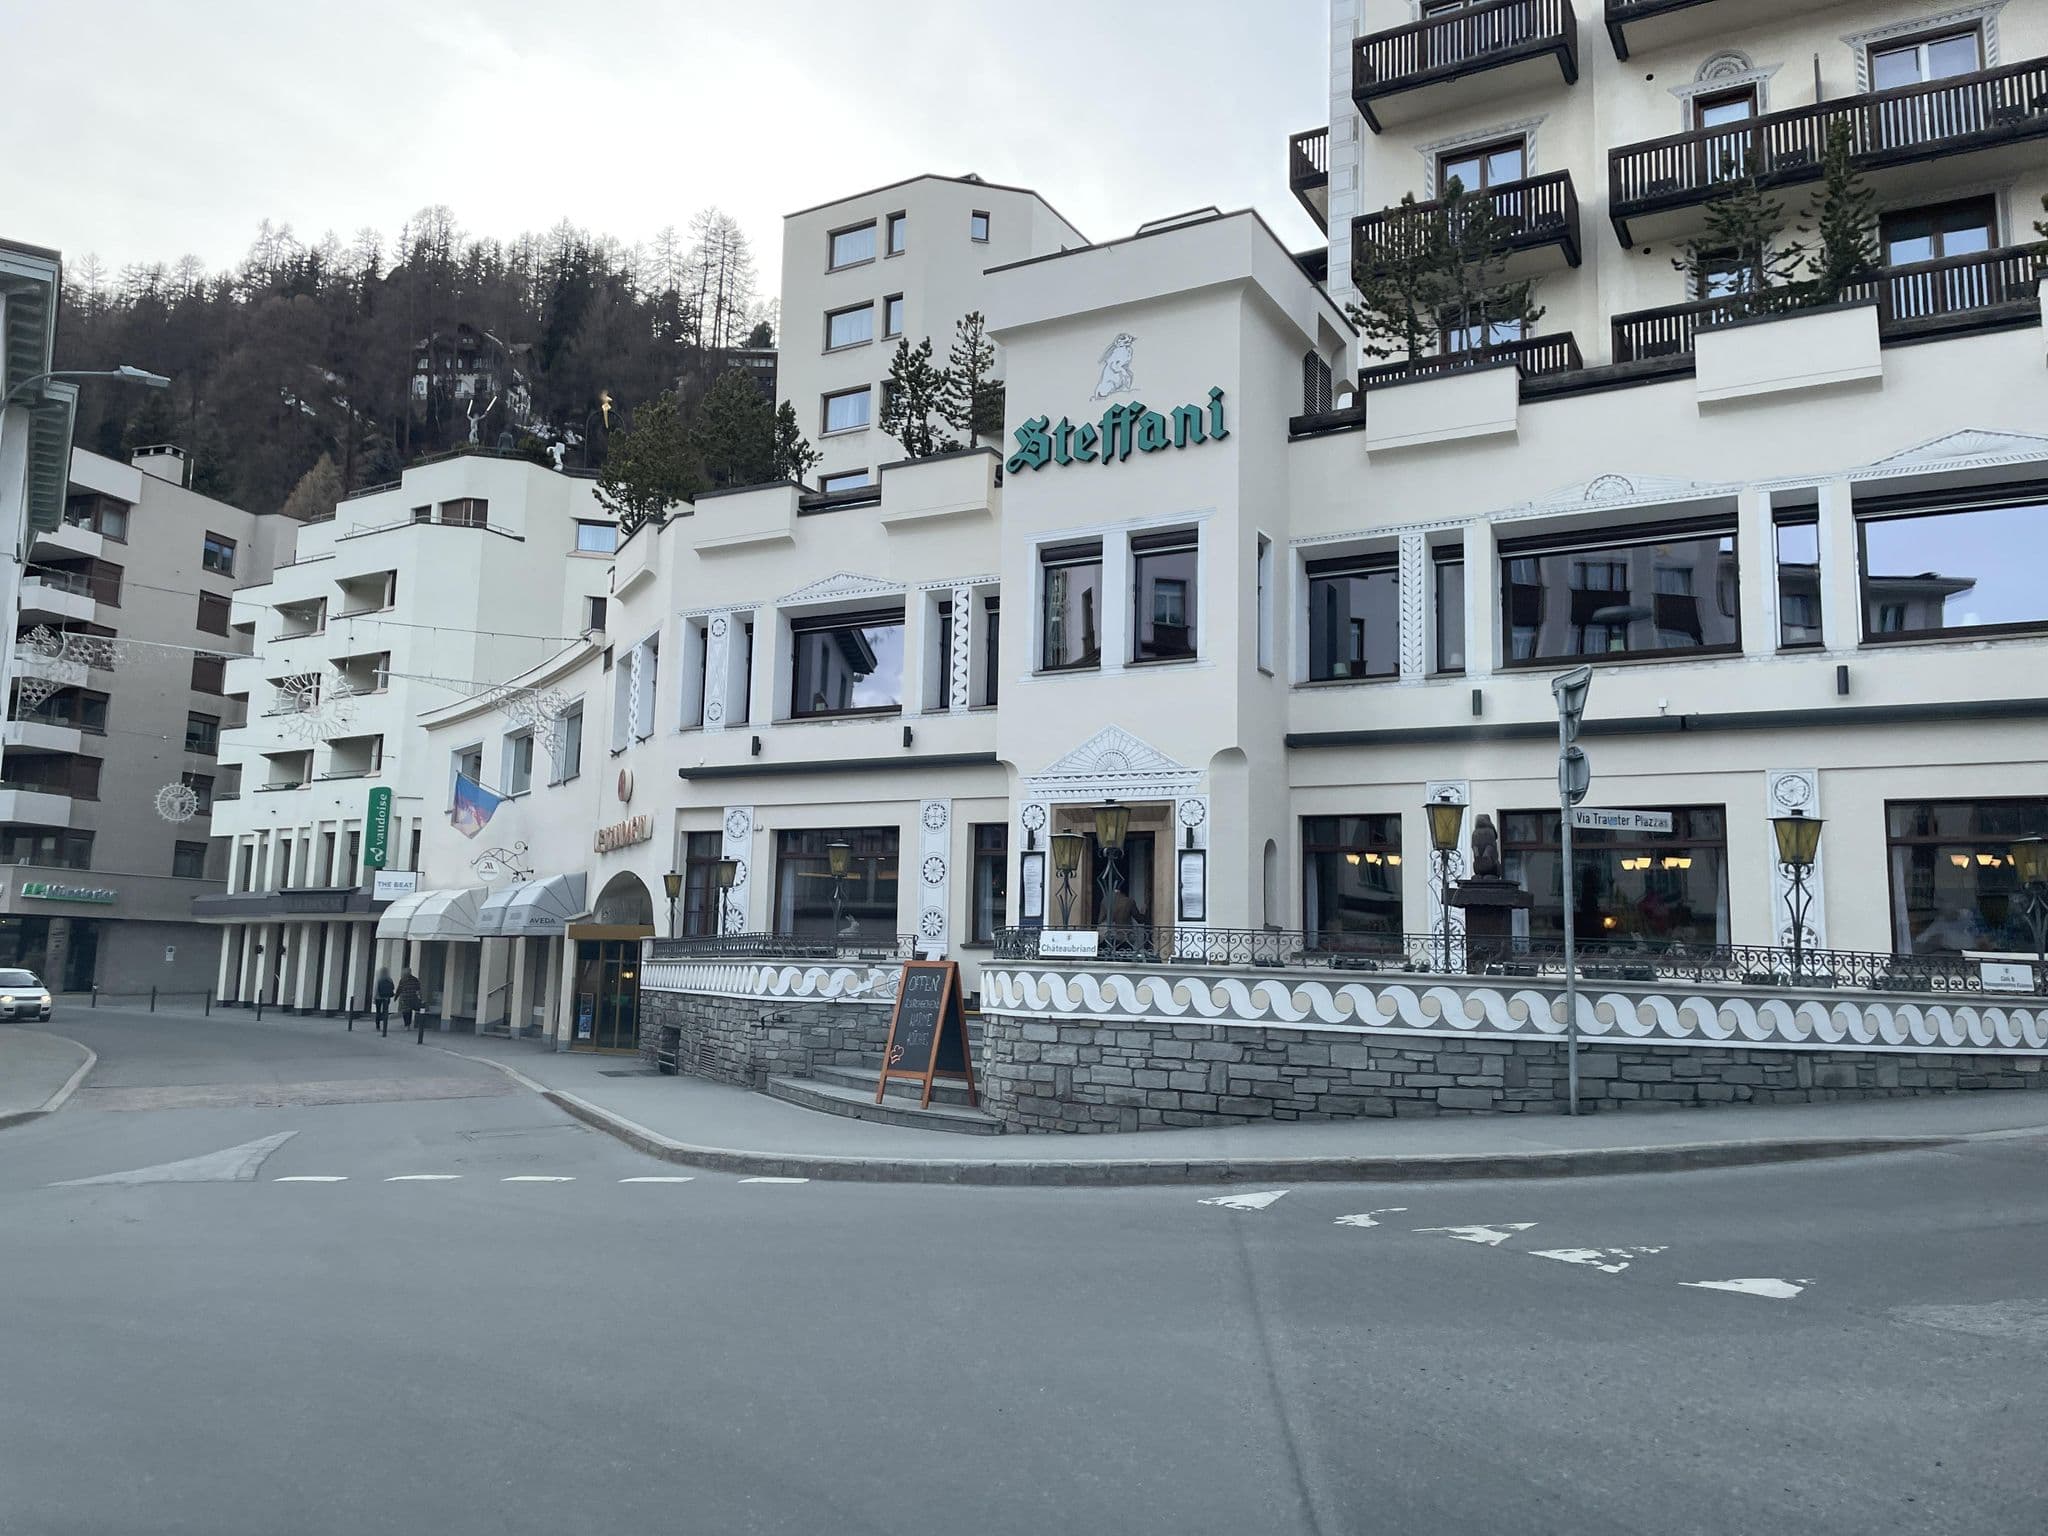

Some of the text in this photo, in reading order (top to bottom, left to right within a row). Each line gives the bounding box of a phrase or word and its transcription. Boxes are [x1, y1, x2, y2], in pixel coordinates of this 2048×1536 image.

[1006, 386, 1230, 474] Steffani
[376, 793, 388, 846] vaudoise
[1576, 812, 1590, 824] Via
[393, 881, 413, 889] BEAT
[908, 974, 941, 992] OFFEN
